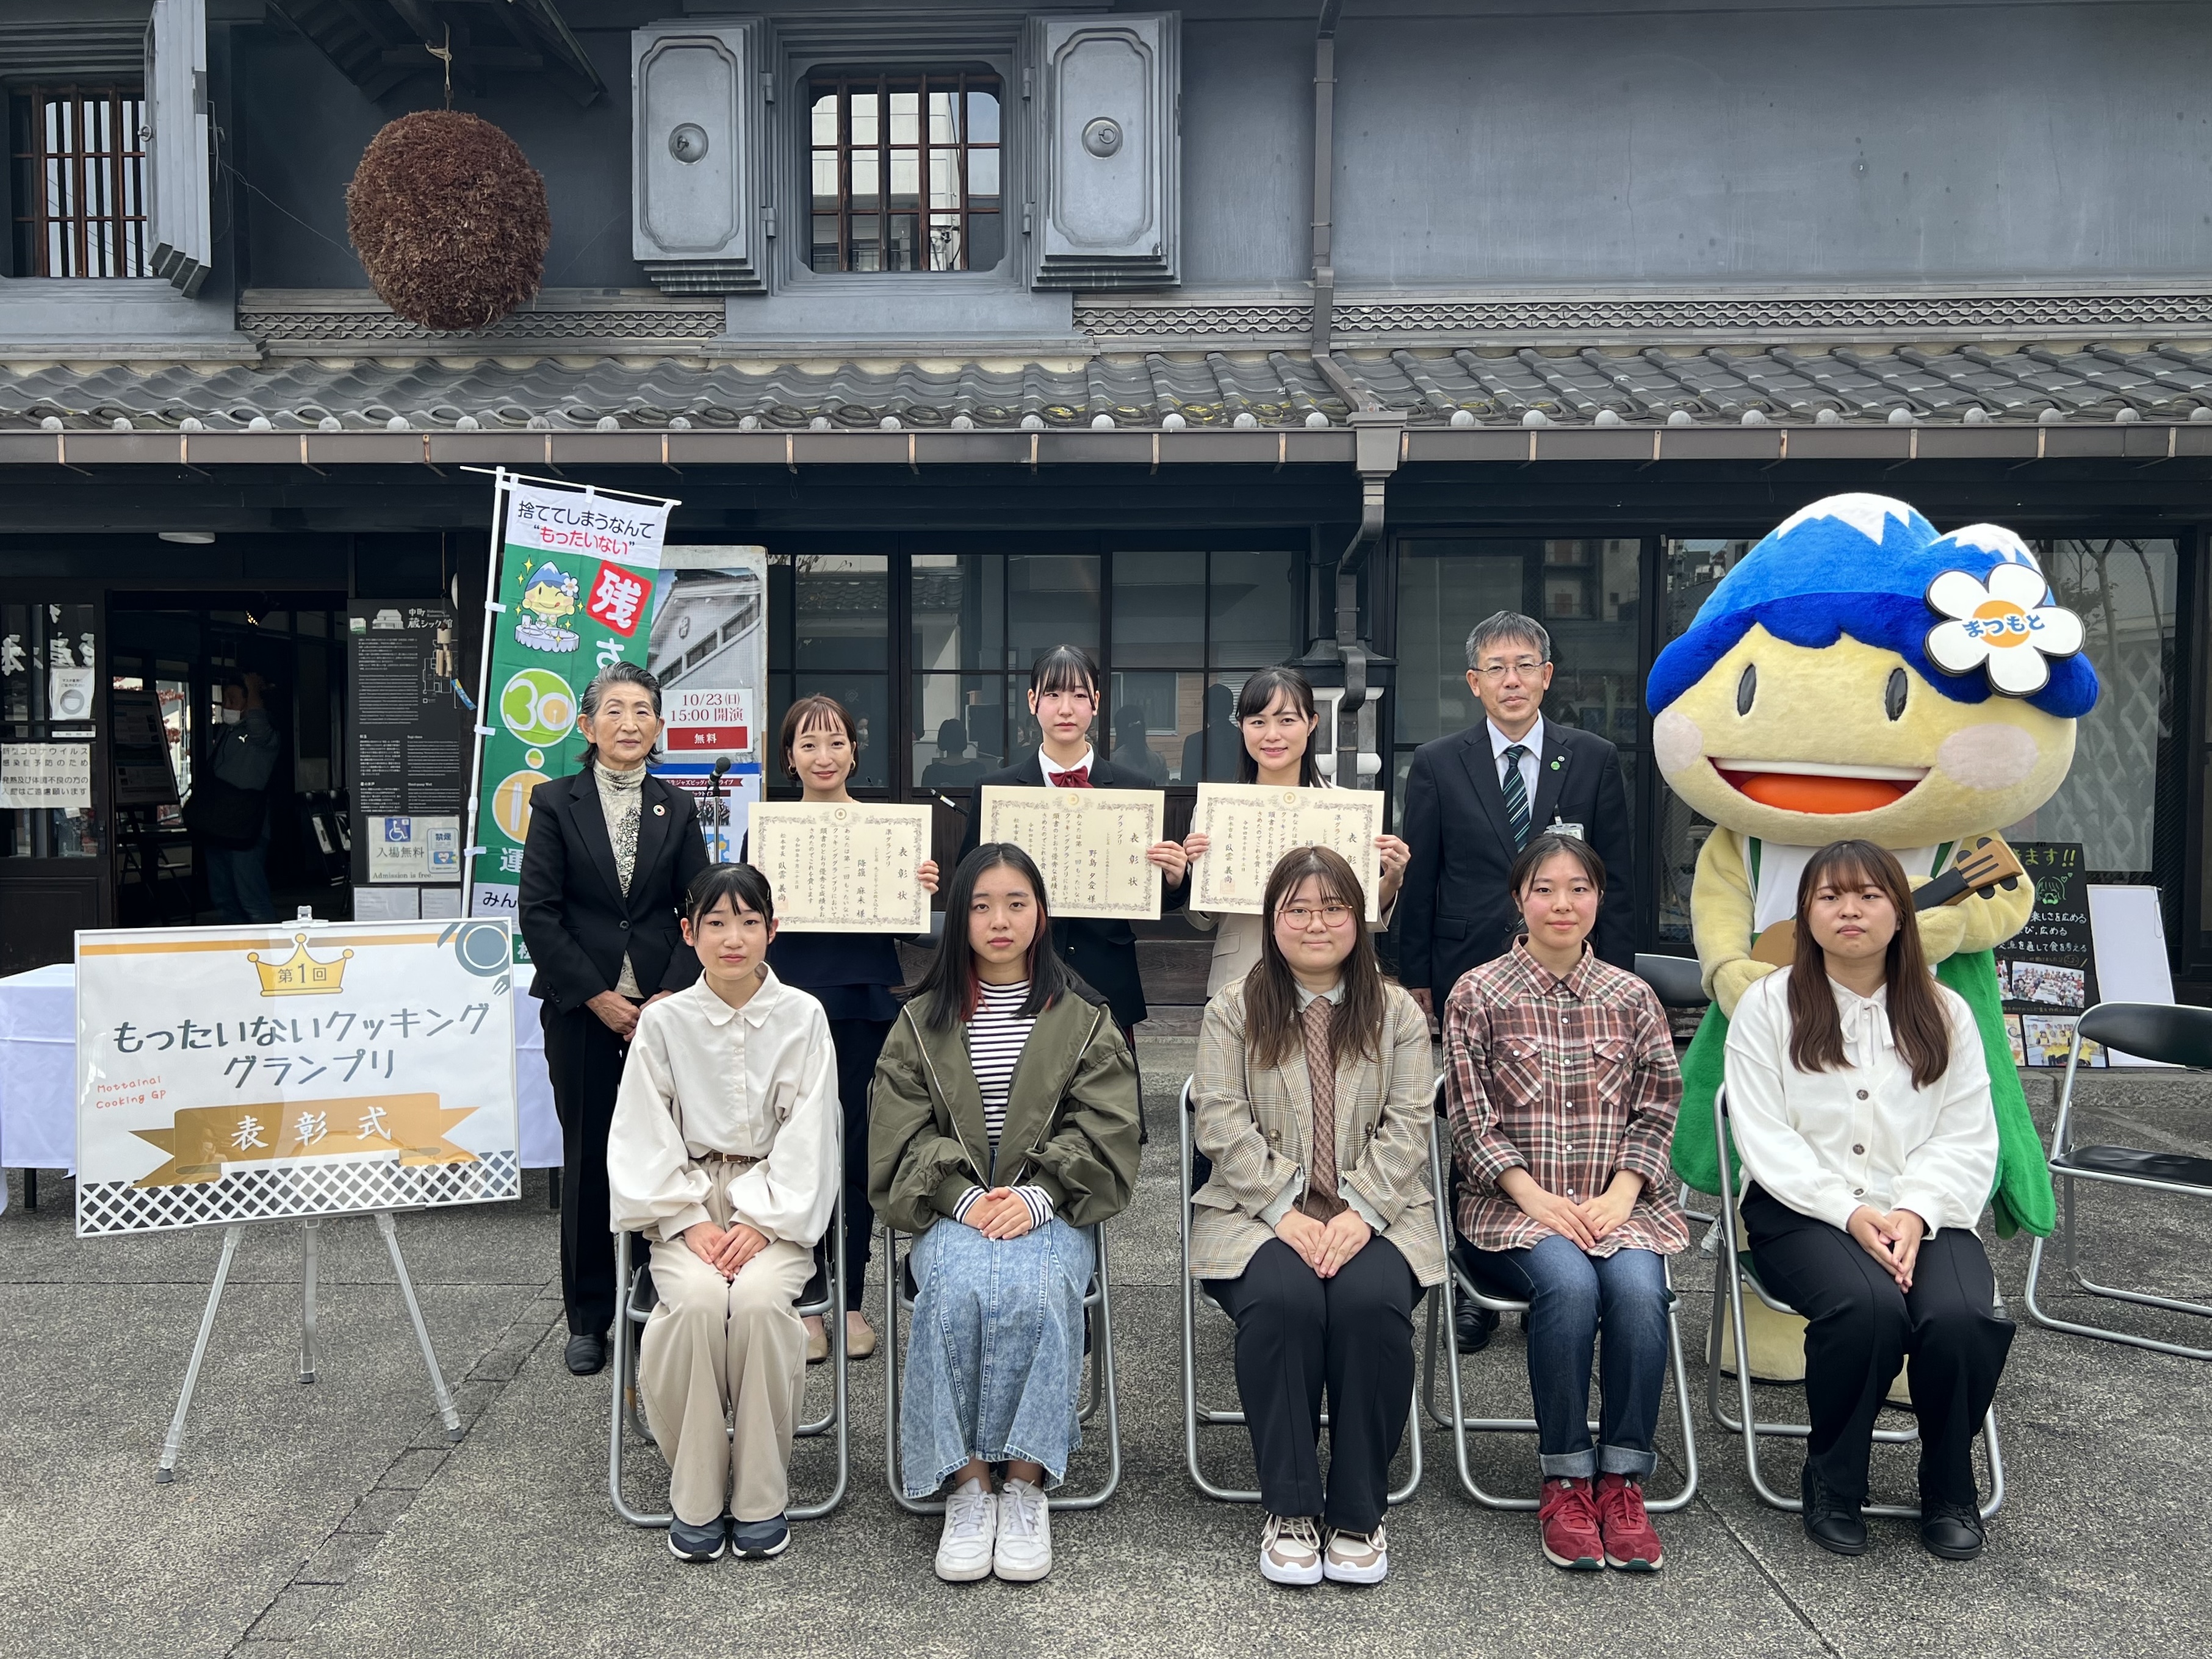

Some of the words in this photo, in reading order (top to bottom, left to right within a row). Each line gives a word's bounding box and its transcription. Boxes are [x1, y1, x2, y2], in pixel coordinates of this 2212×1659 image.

[518, 500, 655, 539] 捨ててしまうなんて
[1962, 614, 2045, 638] まつもと
[671, 709, 710, 722] 15:00
[714, 707, 743, 722] 開演
[694, 733, 717, 744] 無料
[376, 846, 425, 858] 入場無料
[278, 963, 327, 984] 第1回
[113, 1002, 489, 1053] もったいないクッキング
[224, 1048, 394, 1089] グランプリ
[98, 1075, 161, 1093] Mottainai
[96, 1094, 145, 1109] Cooking
[151, 1089, 167, 1099] GP
[231, 1106, 393, 1152] 表彰式
